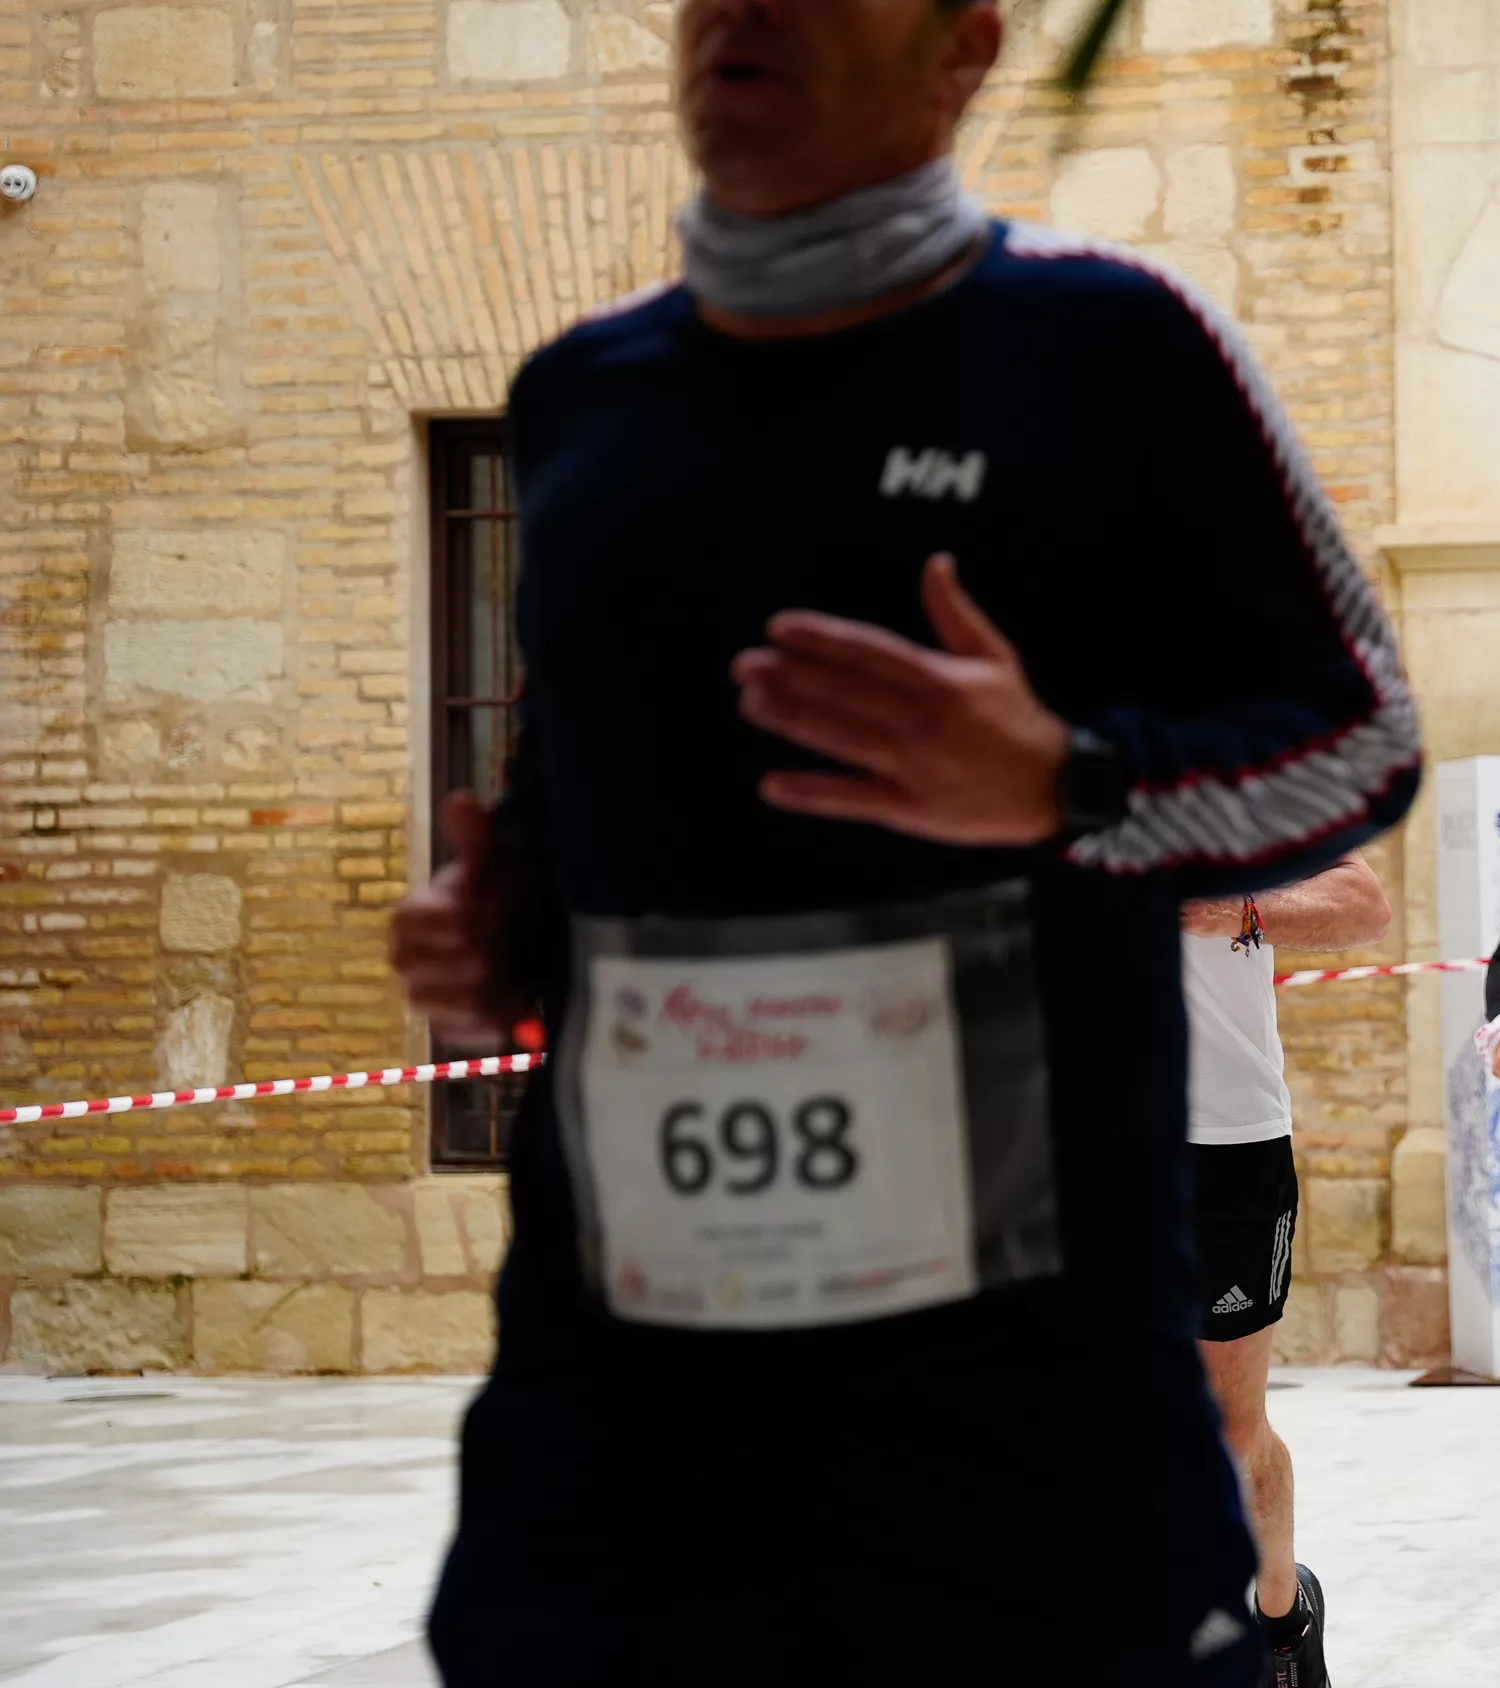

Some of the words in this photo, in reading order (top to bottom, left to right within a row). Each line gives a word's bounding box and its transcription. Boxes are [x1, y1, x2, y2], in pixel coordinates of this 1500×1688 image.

[879, 446, 987, 502] HH
[659, 1093, 862, 1198] 698
[1212, 1299, 1253, 1314] adidas
